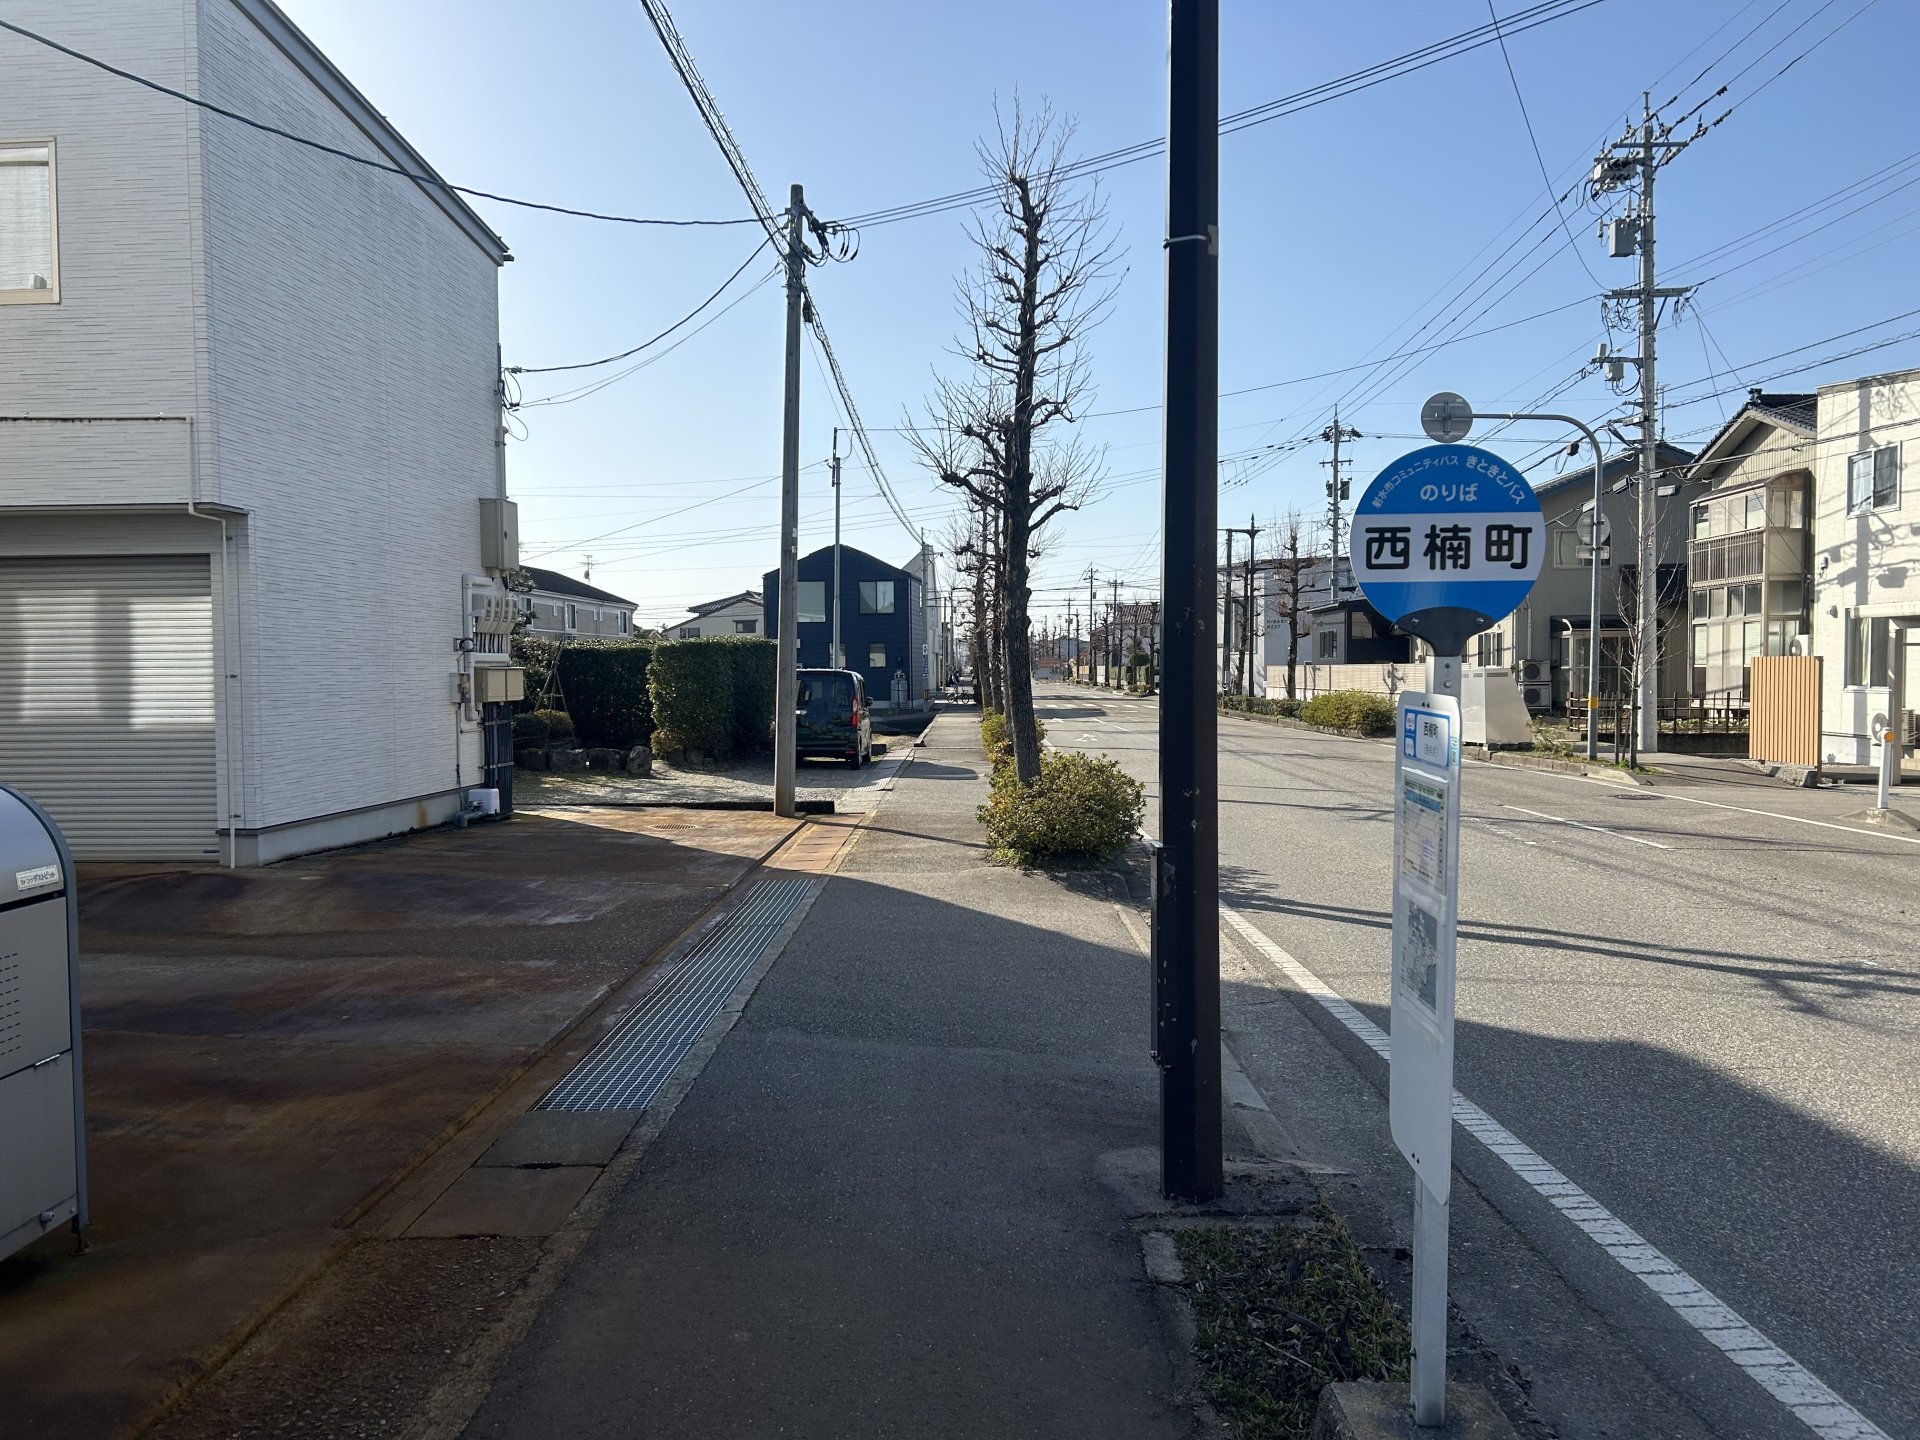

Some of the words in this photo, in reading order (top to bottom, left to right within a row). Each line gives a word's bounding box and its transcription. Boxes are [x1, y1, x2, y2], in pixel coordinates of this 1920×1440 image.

[1371, 455, 1459, 509] 射水市コミュニティバス
[1466, 455, 1526, 505] きときとバス
[1420, 483, 1478, 502] のりば
[1365, 524, 1533, 571] 西楠町
